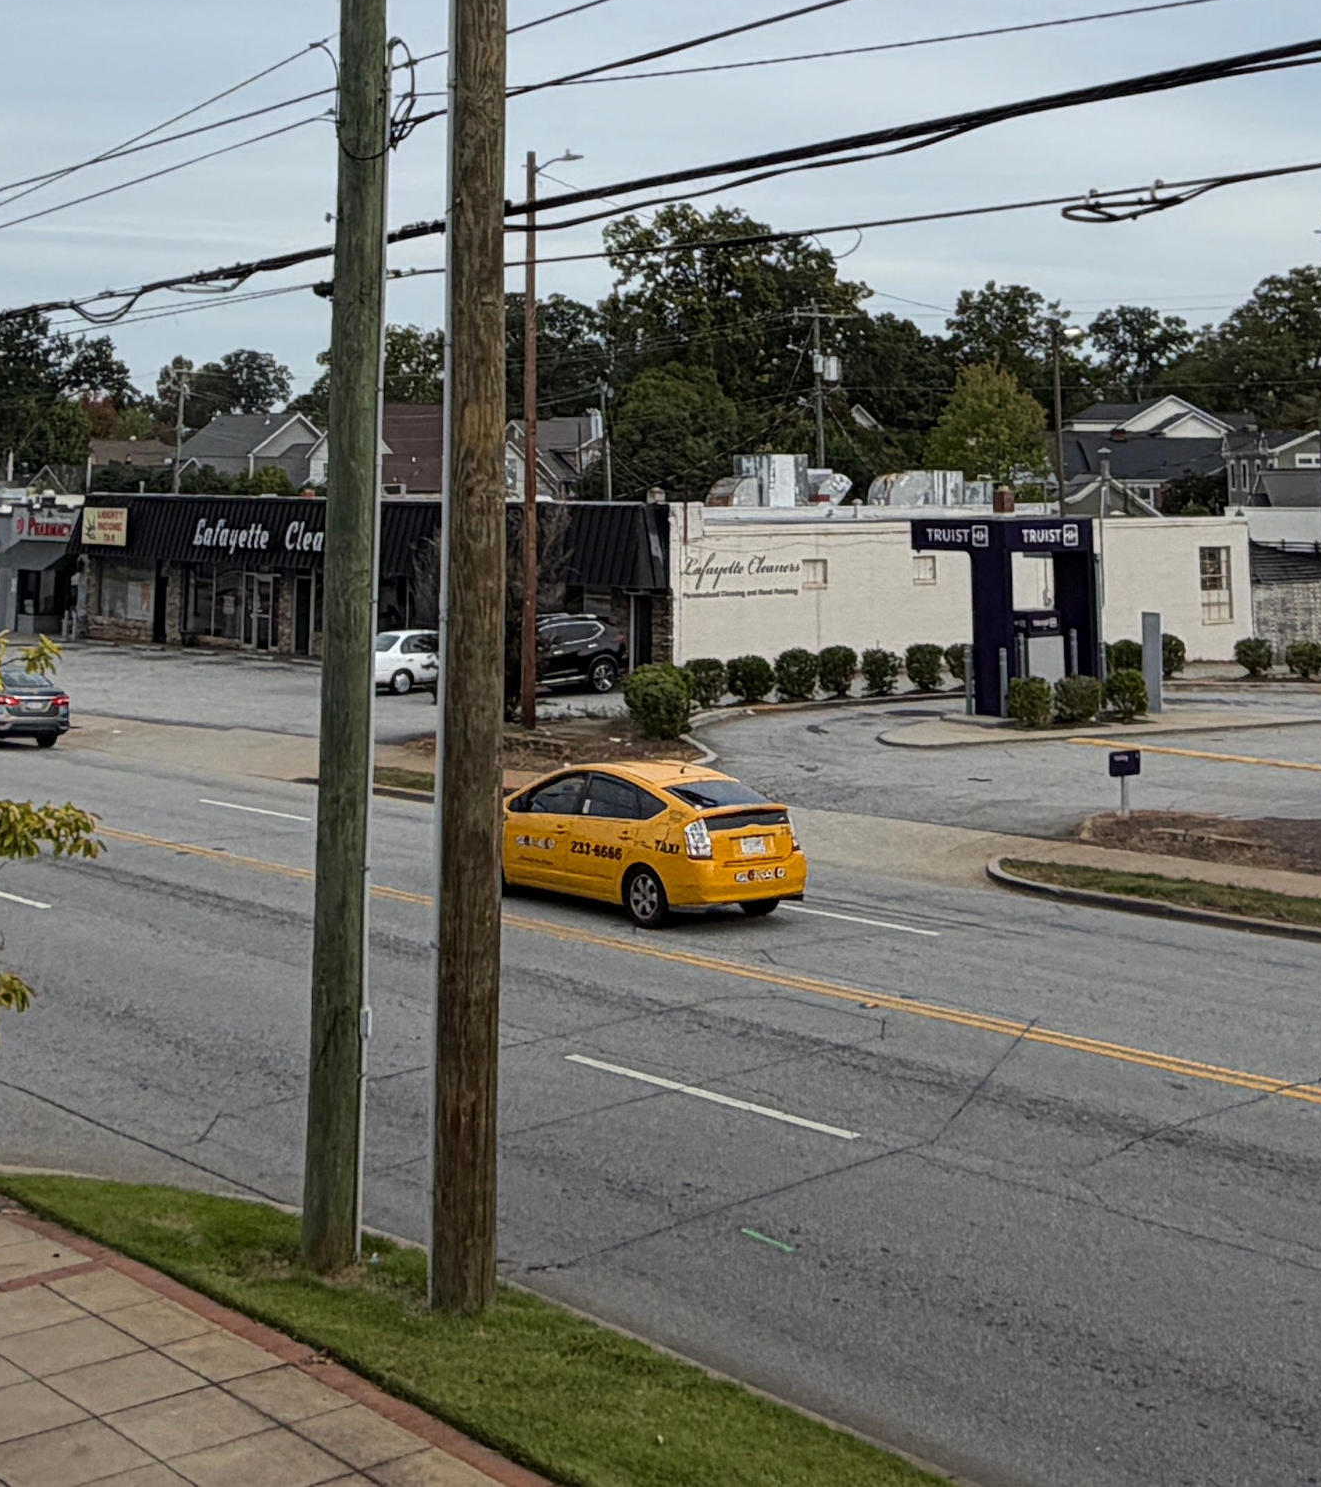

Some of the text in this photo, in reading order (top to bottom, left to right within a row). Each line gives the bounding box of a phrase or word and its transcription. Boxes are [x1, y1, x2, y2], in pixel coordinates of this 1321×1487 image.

[192, 518, 325, 554] Lafayette Clea
[926, 528, 970, 542] TRUIST
[1022, 528, 1061, 543] TRUIST
[682, 552, 800, 590] Lafayette Cleaners
